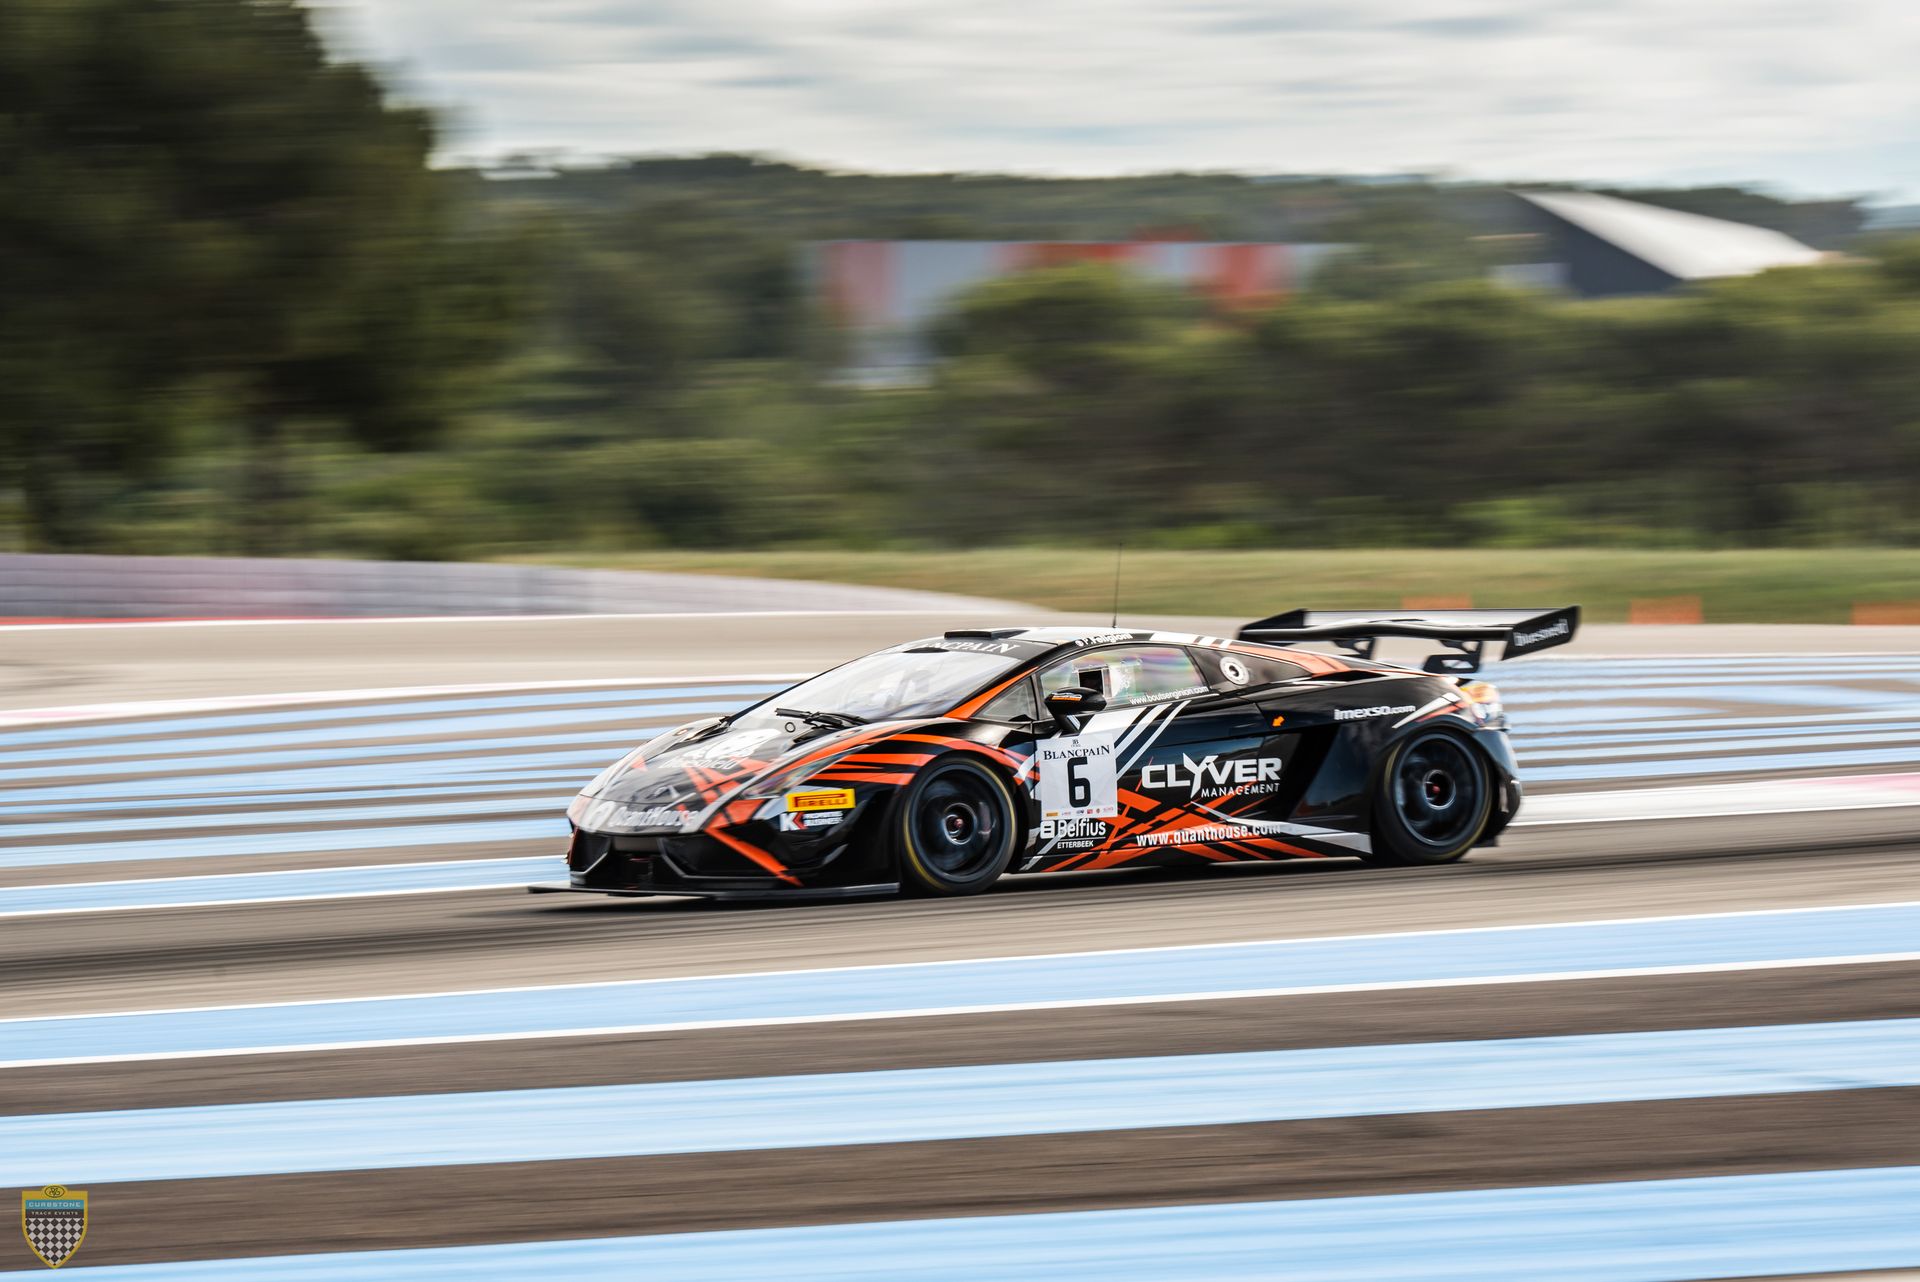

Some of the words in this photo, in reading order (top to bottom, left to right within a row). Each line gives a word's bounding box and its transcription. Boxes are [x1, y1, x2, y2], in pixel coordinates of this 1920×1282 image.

[1043, 744, 1110, 761] BLANCPAIN
[1067, 756, 1092, 808] 6
[1141, 752, 1282, 798] CLYVER
[1201, 783, 1280, 798] MANAGEMENT
[793, 793, 848, 808] PIRELLI
[1058, 817, 1106, 838] Belfius
[1136, 824, 1281, 847] www.quanthouse.com
[1057, 840, 1093, 849] ETTERBEEK
